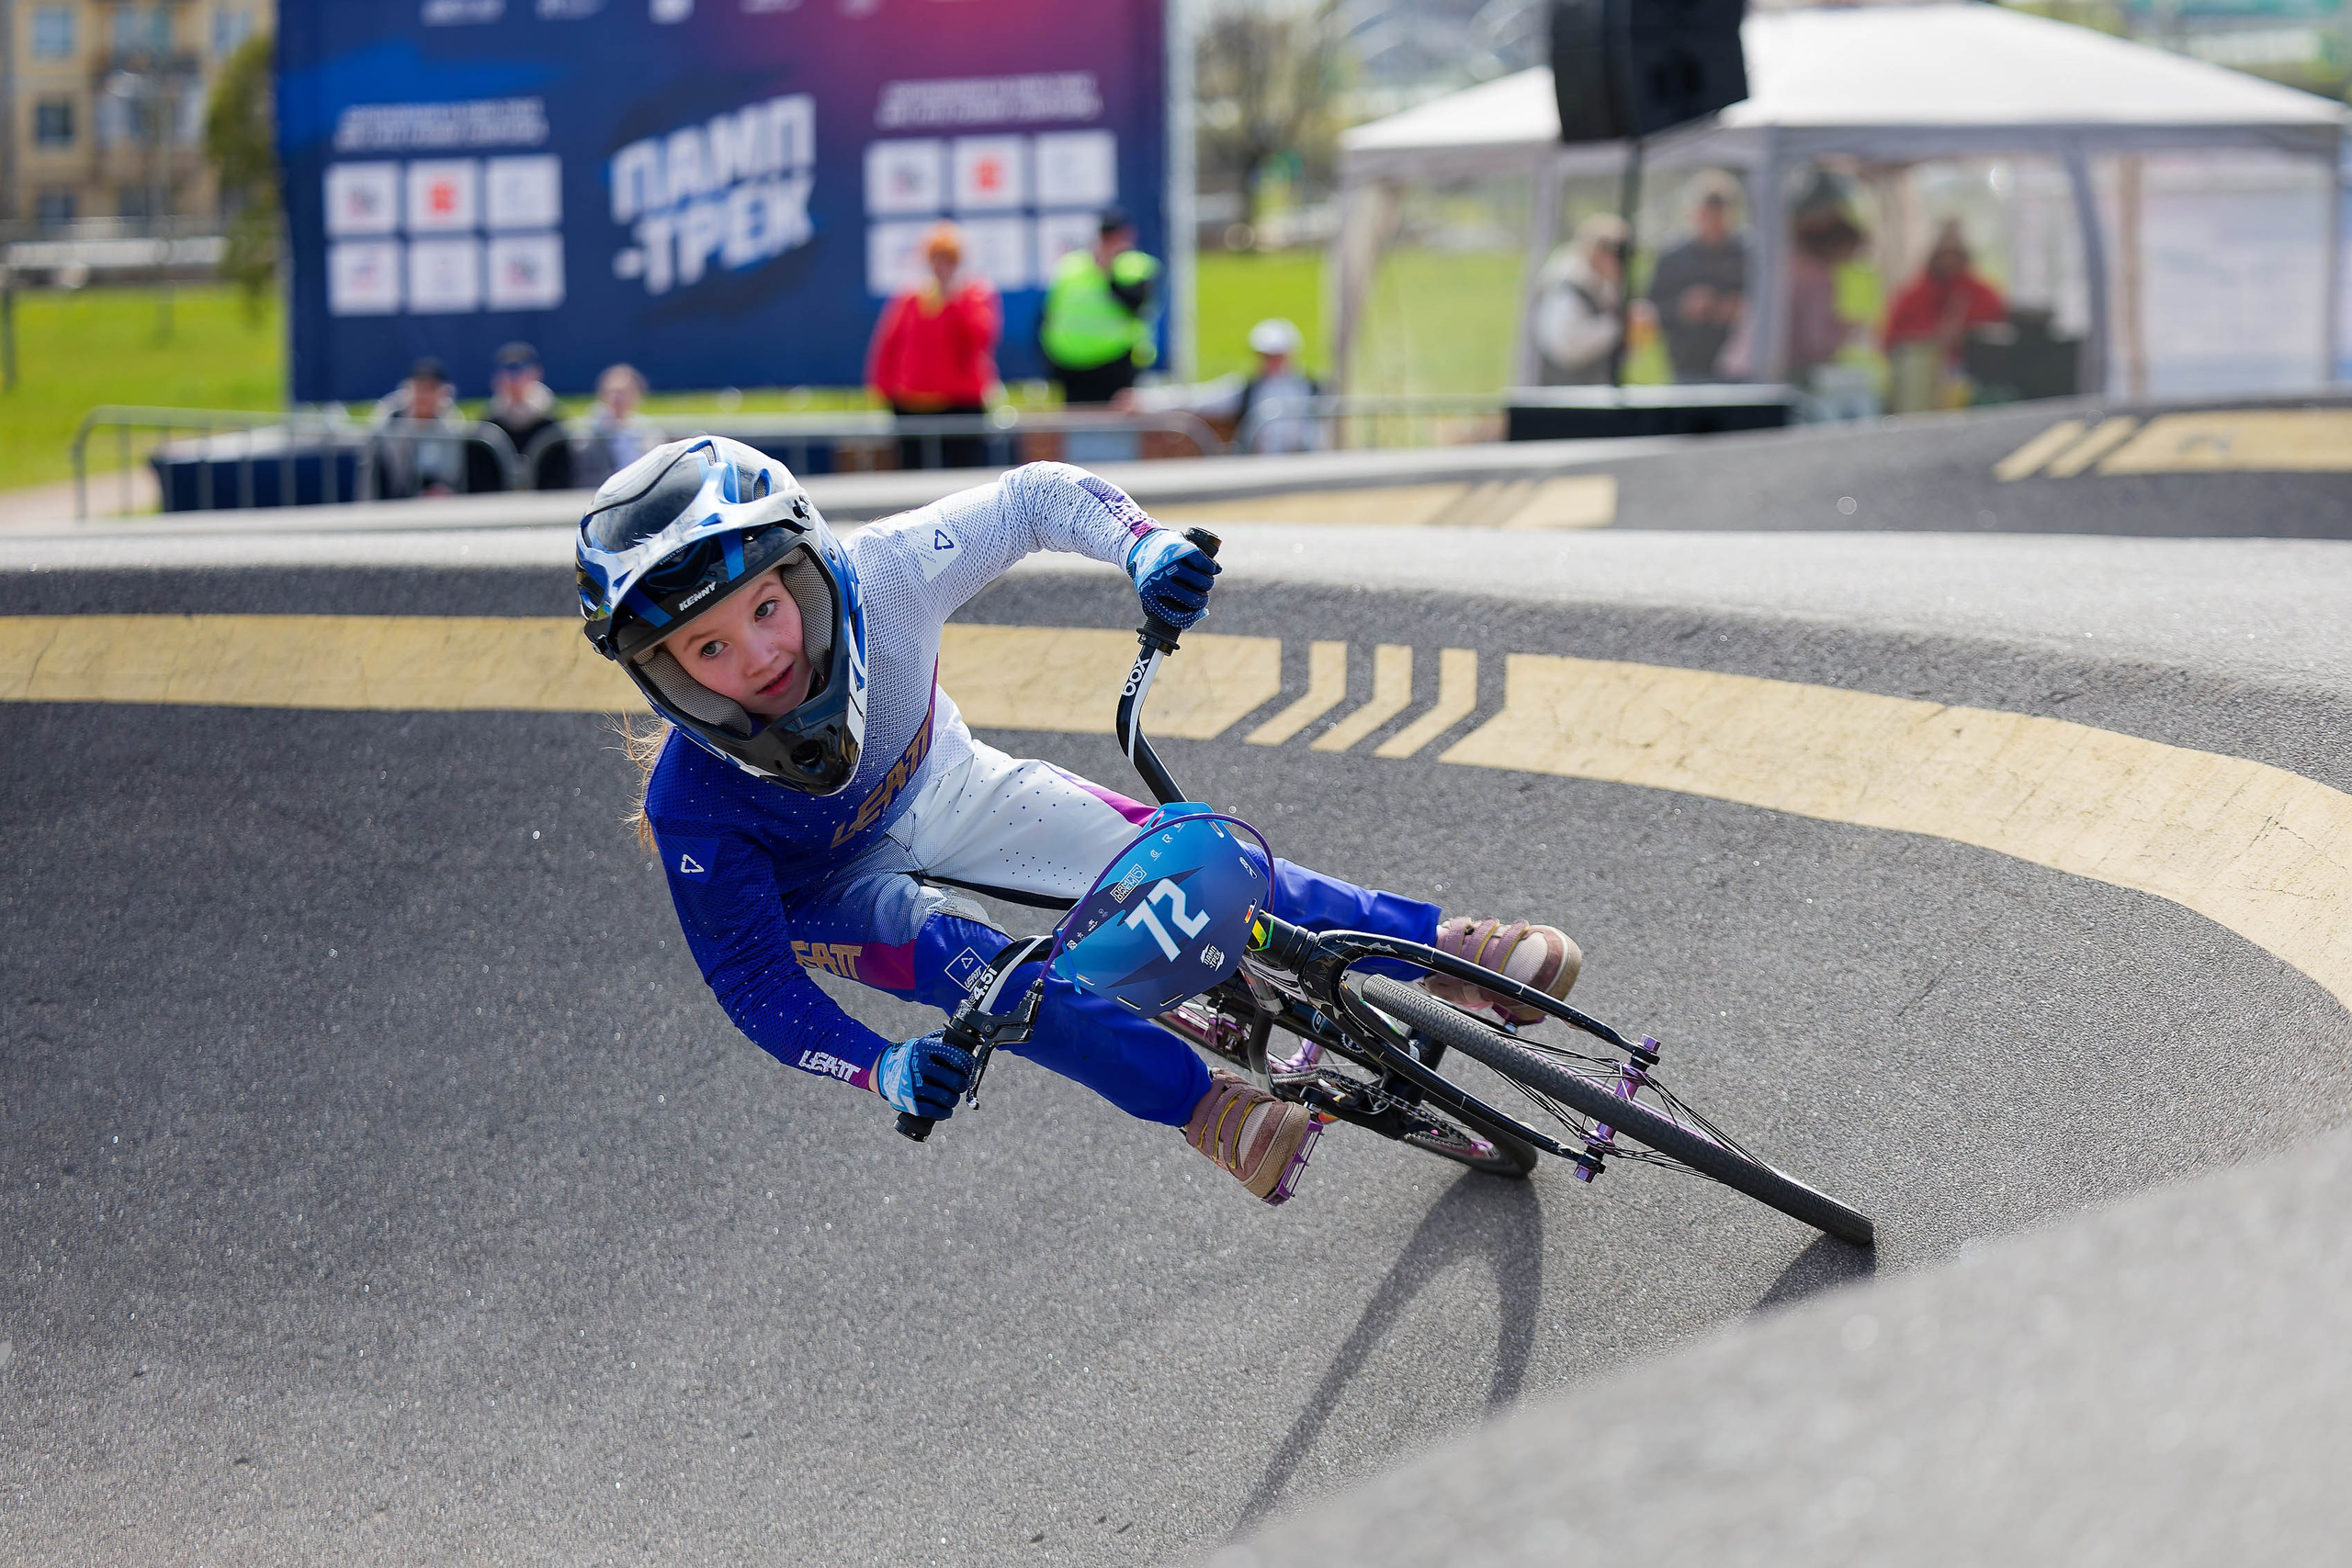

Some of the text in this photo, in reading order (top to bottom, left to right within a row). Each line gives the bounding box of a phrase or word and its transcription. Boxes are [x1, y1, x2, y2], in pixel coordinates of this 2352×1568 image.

[610, 93, 817, 225] ПАМП
[679, 581, 717, 612] KENNY
[831, 705, 933, 849] LEATT
[1124, 878, 1211, 963] 72
[790, 940, 863, 979] EATT
[965, 965, 982, 988] LEATT
[798, 1049, 862, 1082] LEATT
